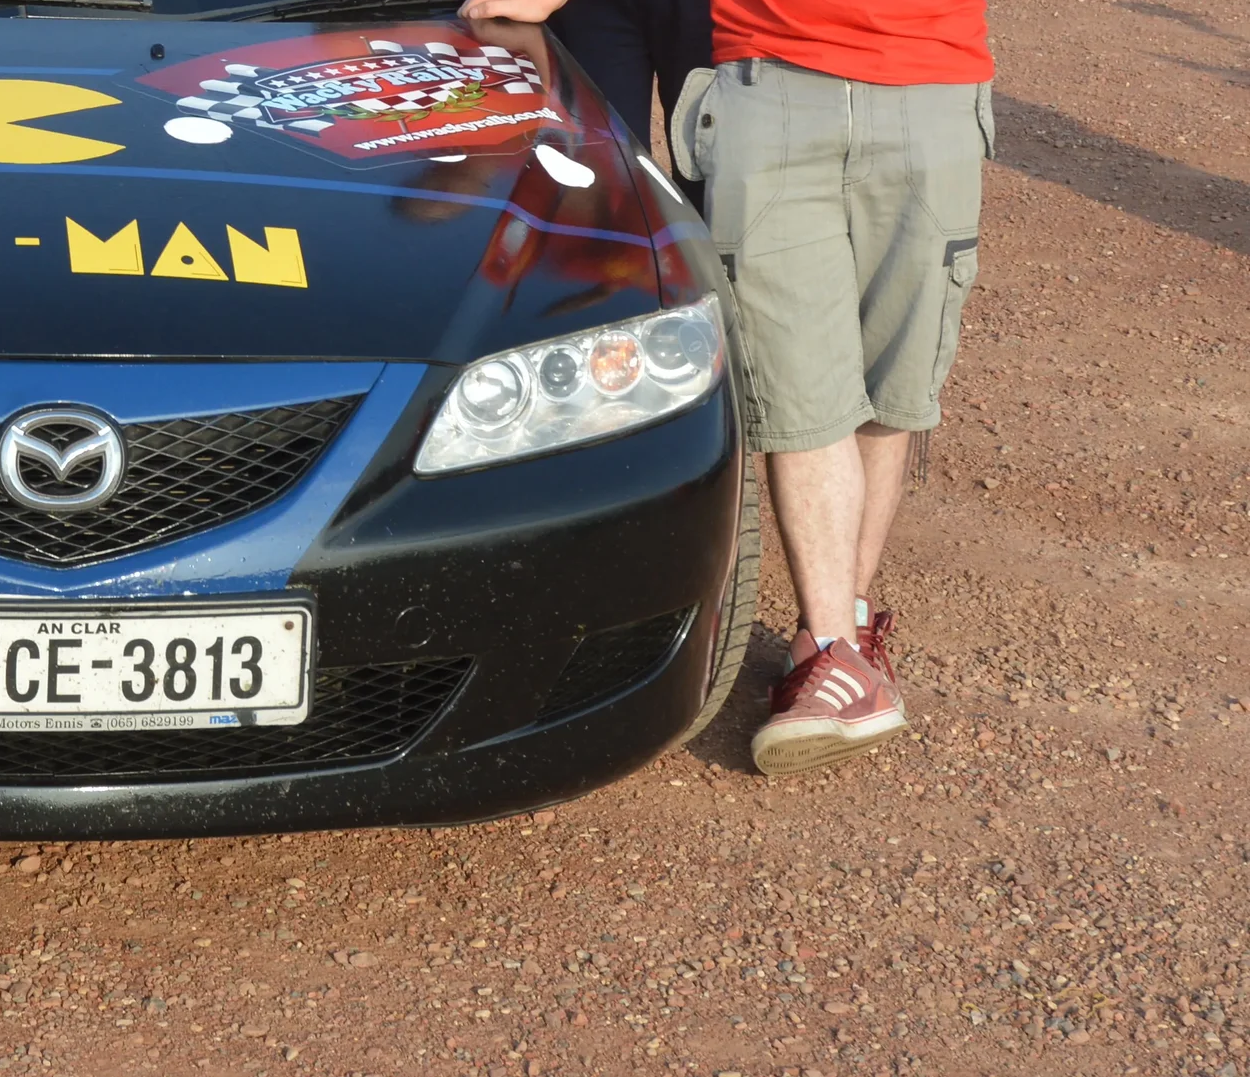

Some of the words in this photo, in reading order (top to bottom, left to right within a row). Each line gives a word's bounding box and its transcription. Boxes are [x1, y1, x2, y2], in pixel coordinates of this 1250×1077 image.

[261, 80, 383, 112] Wacky
[381, 66, 486, 87] Rally
[37, 622, 65, 635] AN
[71, 622, 121, 635] CLAR
[45, 718, 83, 729] Ennis
[106, 717, 138, 731] (065)
[141, 716, 194, 728] 6829199
